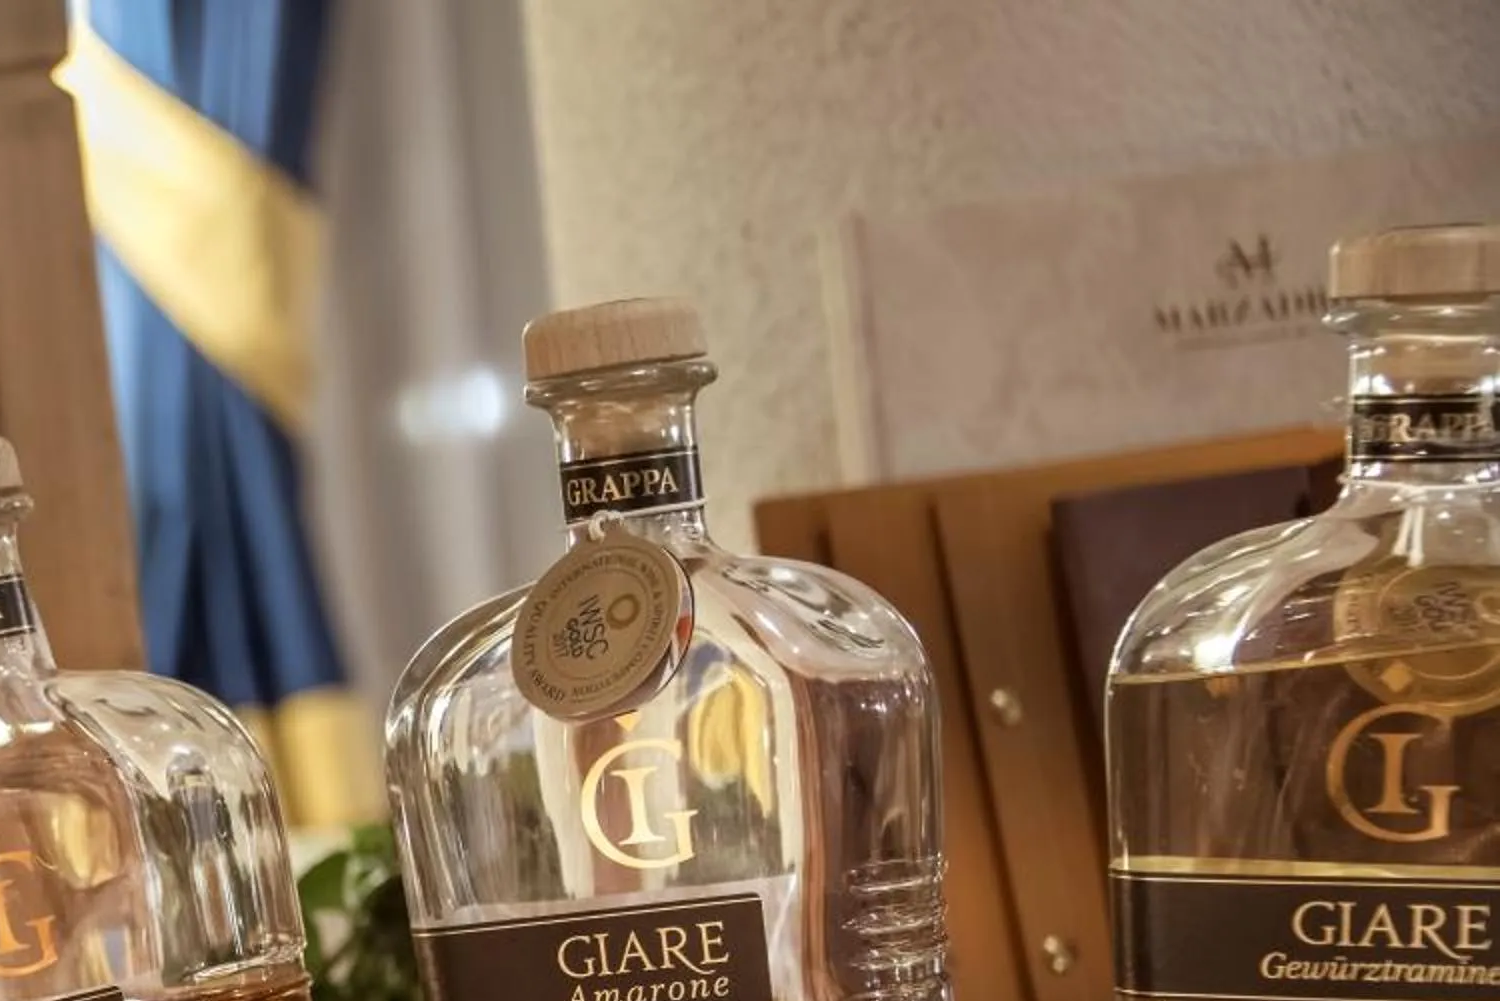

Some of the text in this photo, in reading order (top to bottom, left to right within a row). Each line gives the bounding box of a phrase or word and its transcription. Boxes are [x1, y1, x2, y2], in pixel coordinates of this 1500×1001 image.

[1152, 285, 1338, 333] MARZADR
[566, 465, 680, 507] GRAPPA
[557, 919, 730, 978] GIARE
[1291, 899, 1493, 960] GIARE
